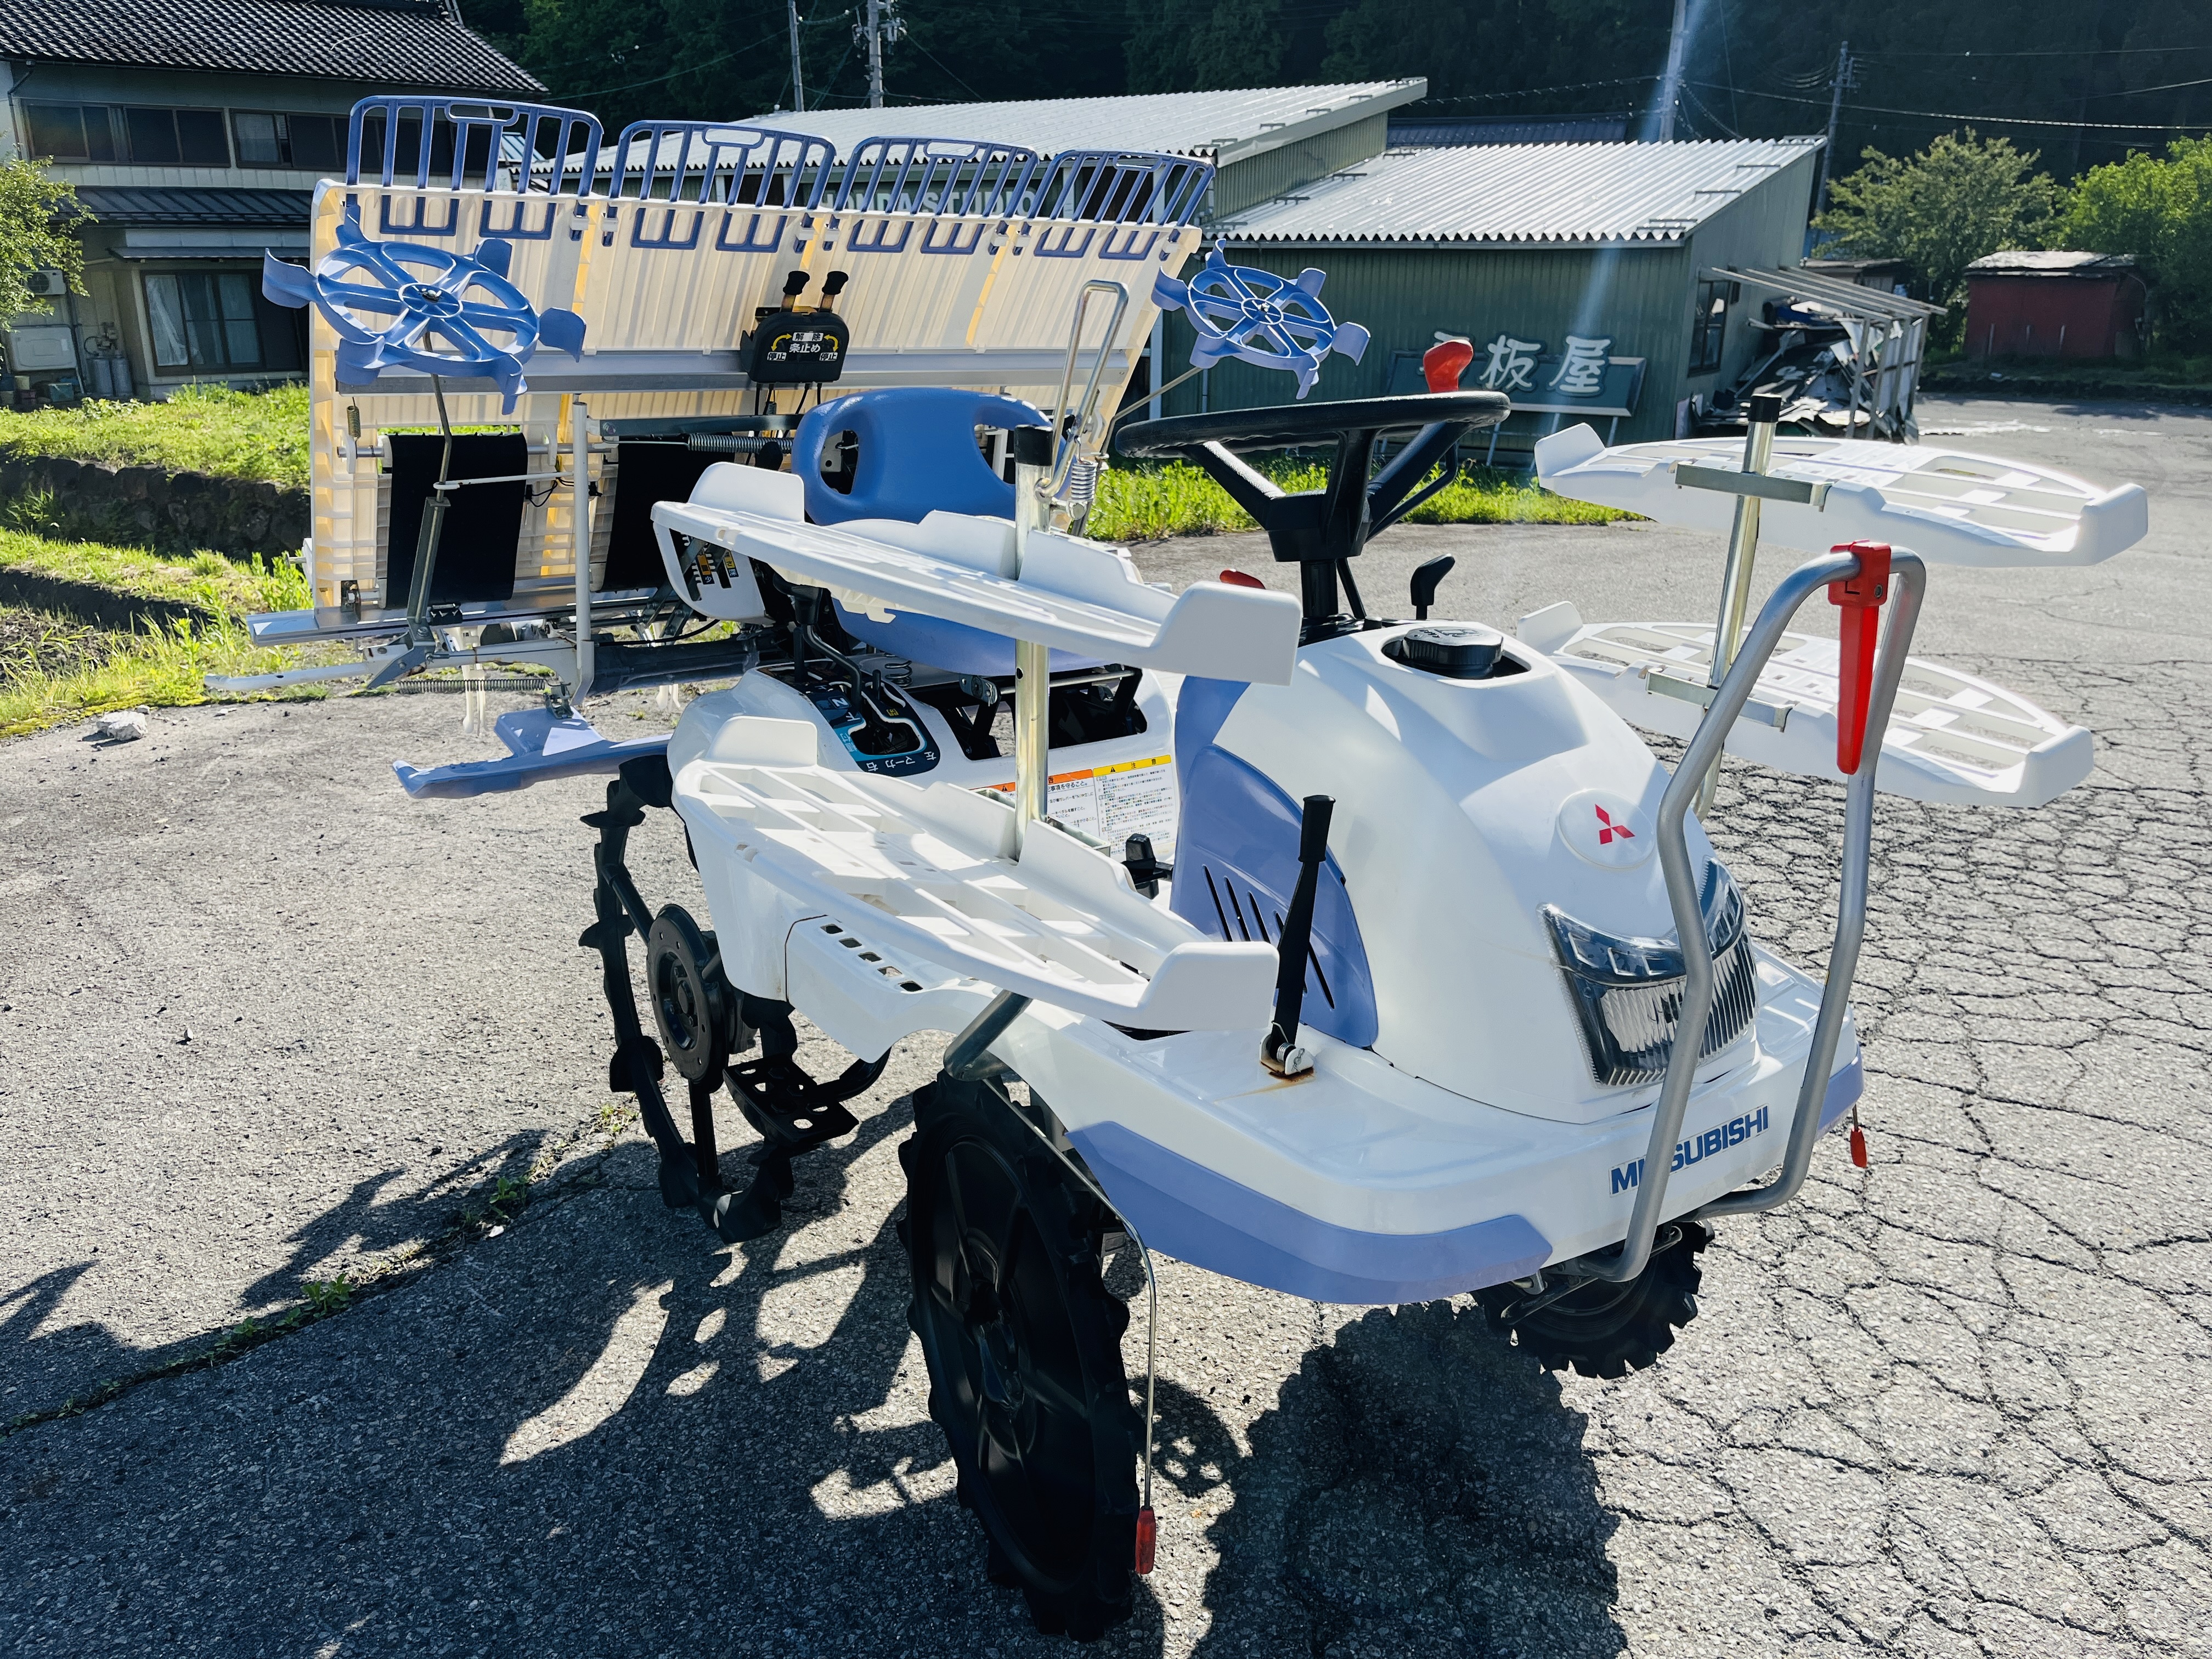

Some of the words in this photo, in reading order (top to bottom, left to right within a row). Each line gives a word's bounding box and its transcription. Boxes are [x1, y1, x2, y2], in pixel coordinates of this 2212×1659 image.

[789, 343, 821, 353] 条止め
[769, 352, 786, 360] 停止
[820, 353, 838, 361] 停止
[1420, 331, 1611, 393] 板屋
[832, 697, 848, 707] N
[924, 751, 936, 760] 左
[866, 761, 879, 772] 右
[885, 755, 916, 769] マーカ
[1611, 1105, 1768, 1194] MISUBISHI
